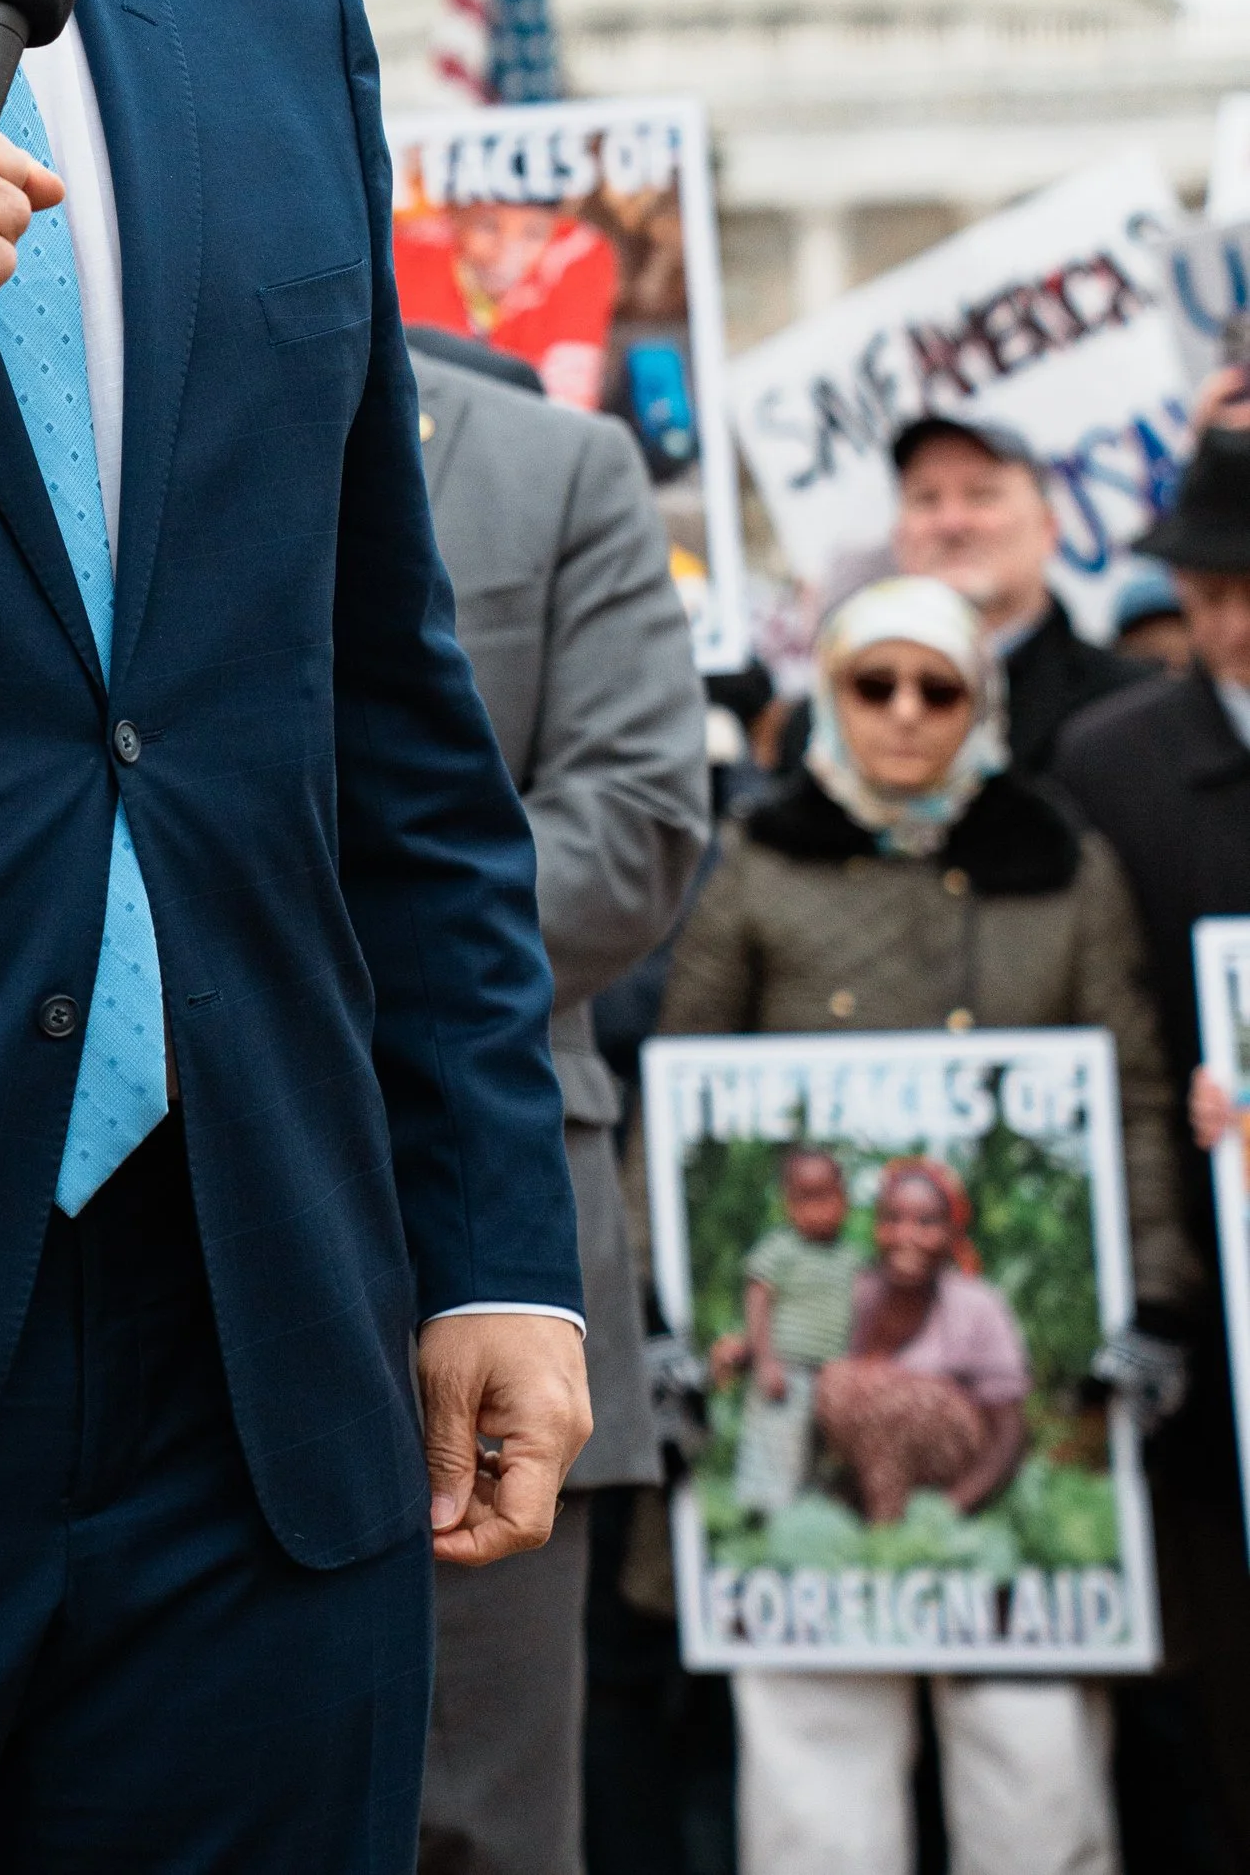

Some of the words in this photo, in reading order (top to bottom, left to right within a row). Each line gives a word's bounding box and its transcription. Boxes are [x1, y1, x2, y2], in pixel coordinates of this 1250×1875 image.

[418, 128, 600, 207] FACES
[604, 121, 680, 195] OF
[753, 328, 900, 491] SAVE
[668, 1062, 803, 1143] THE
[806, 1059, 998, 1143] FACES
[1002, 1059, 1090, 1139] OF
[708, 1568, 993, 1646] FOREIGN
[1008, 1568, 1122, 1646] AID
